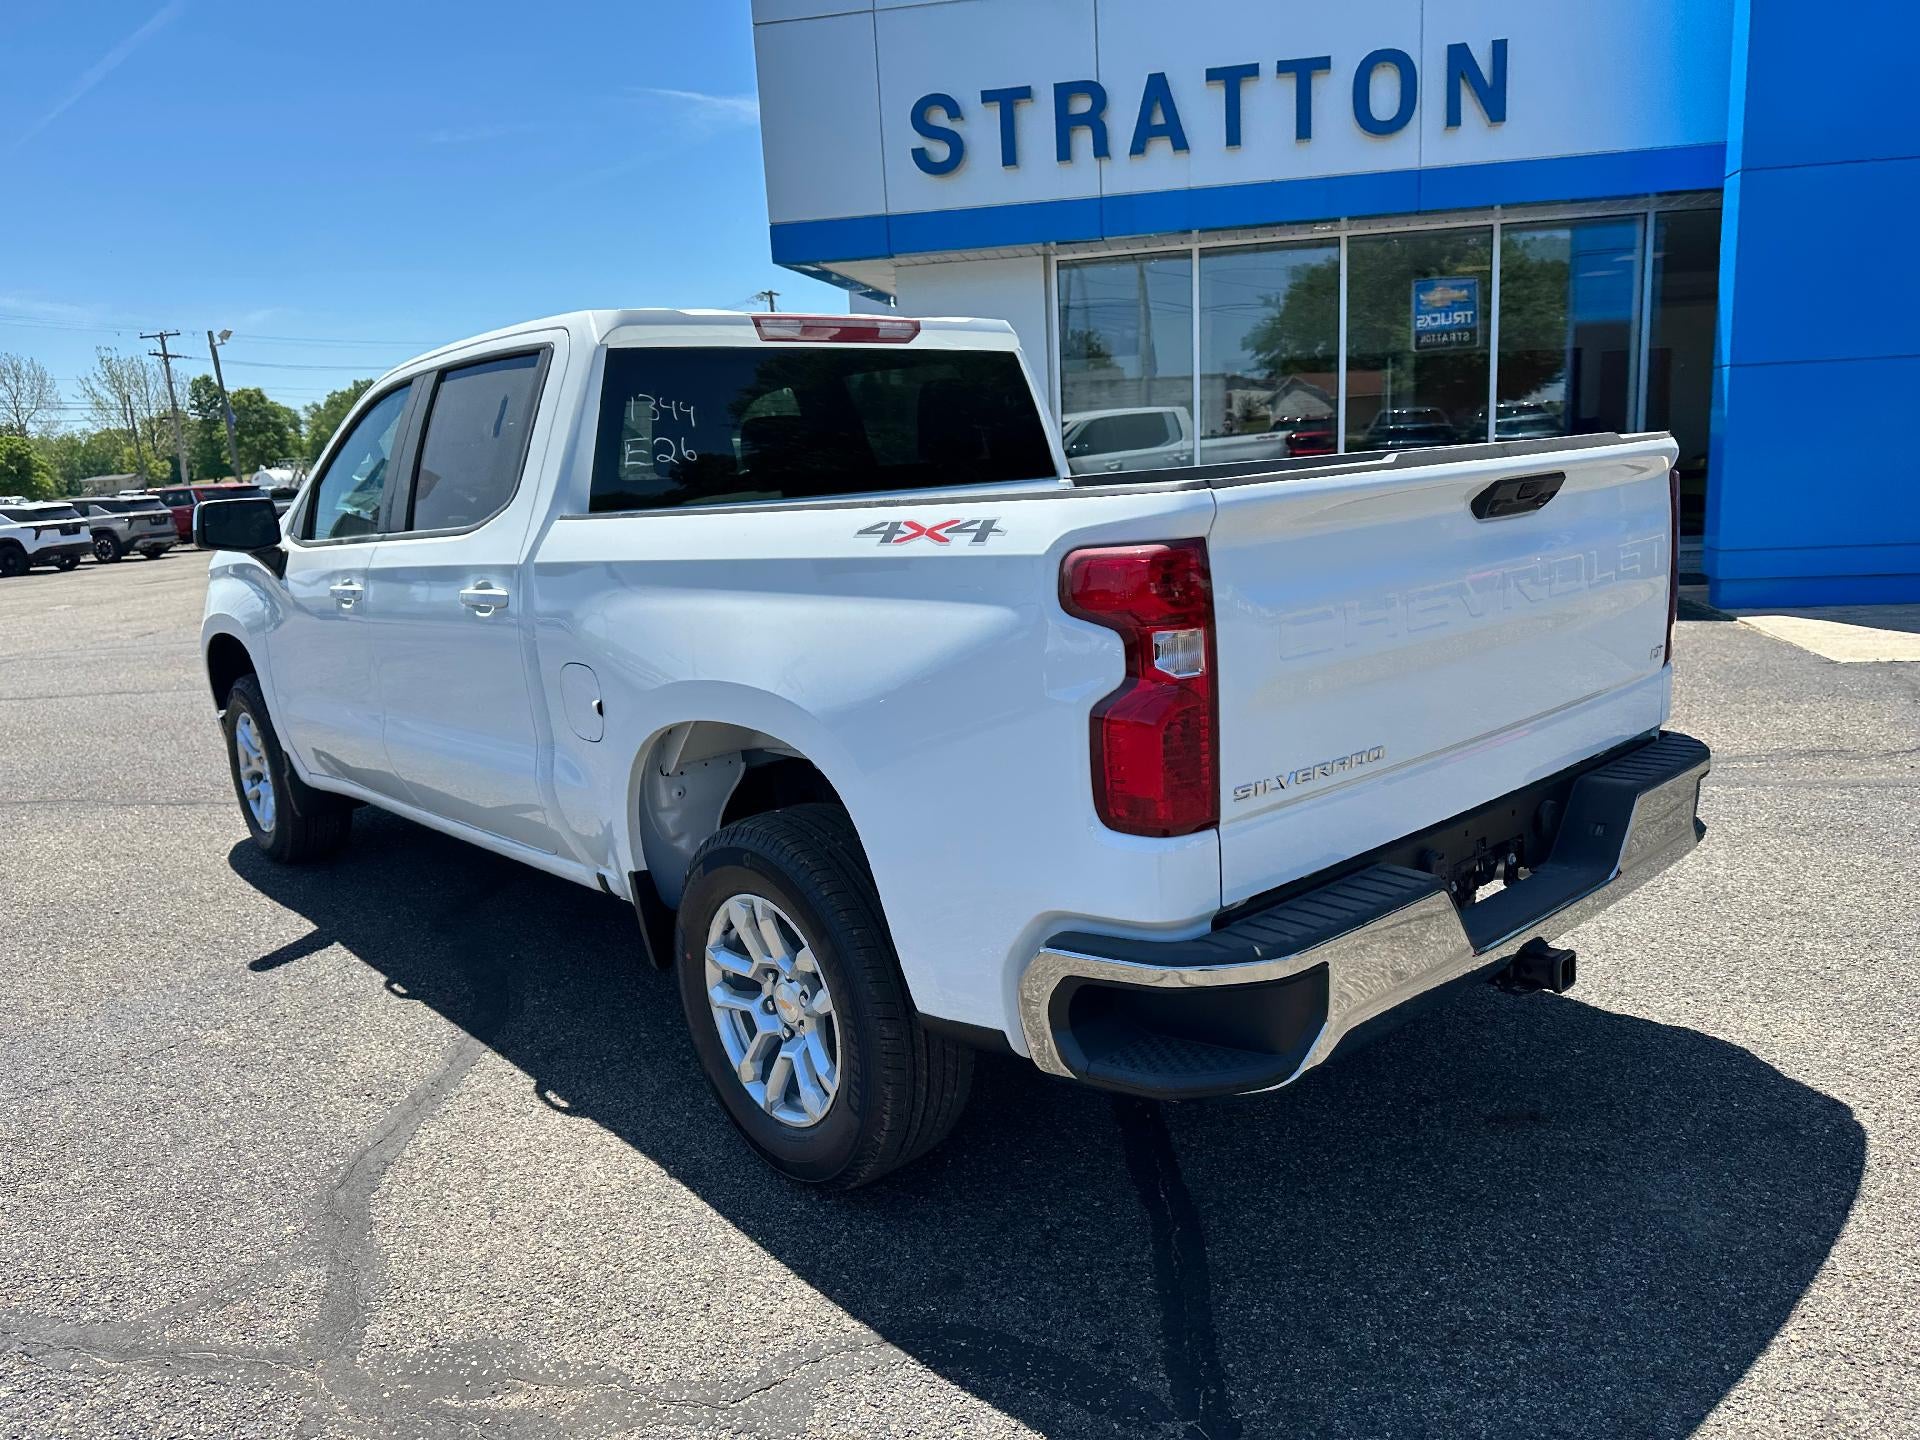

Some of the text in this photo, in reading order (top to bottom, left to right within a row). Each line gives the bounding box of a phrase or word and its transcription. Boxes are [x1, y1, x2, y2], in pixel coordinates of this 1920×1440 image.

[910, 38, 1509, 176] STRATTON
[629, 393, 696, 428] 1344
[1279, 534, 1666, 661] CHEVROLET
[1233, 744, 1385, 802] SILVERADO
